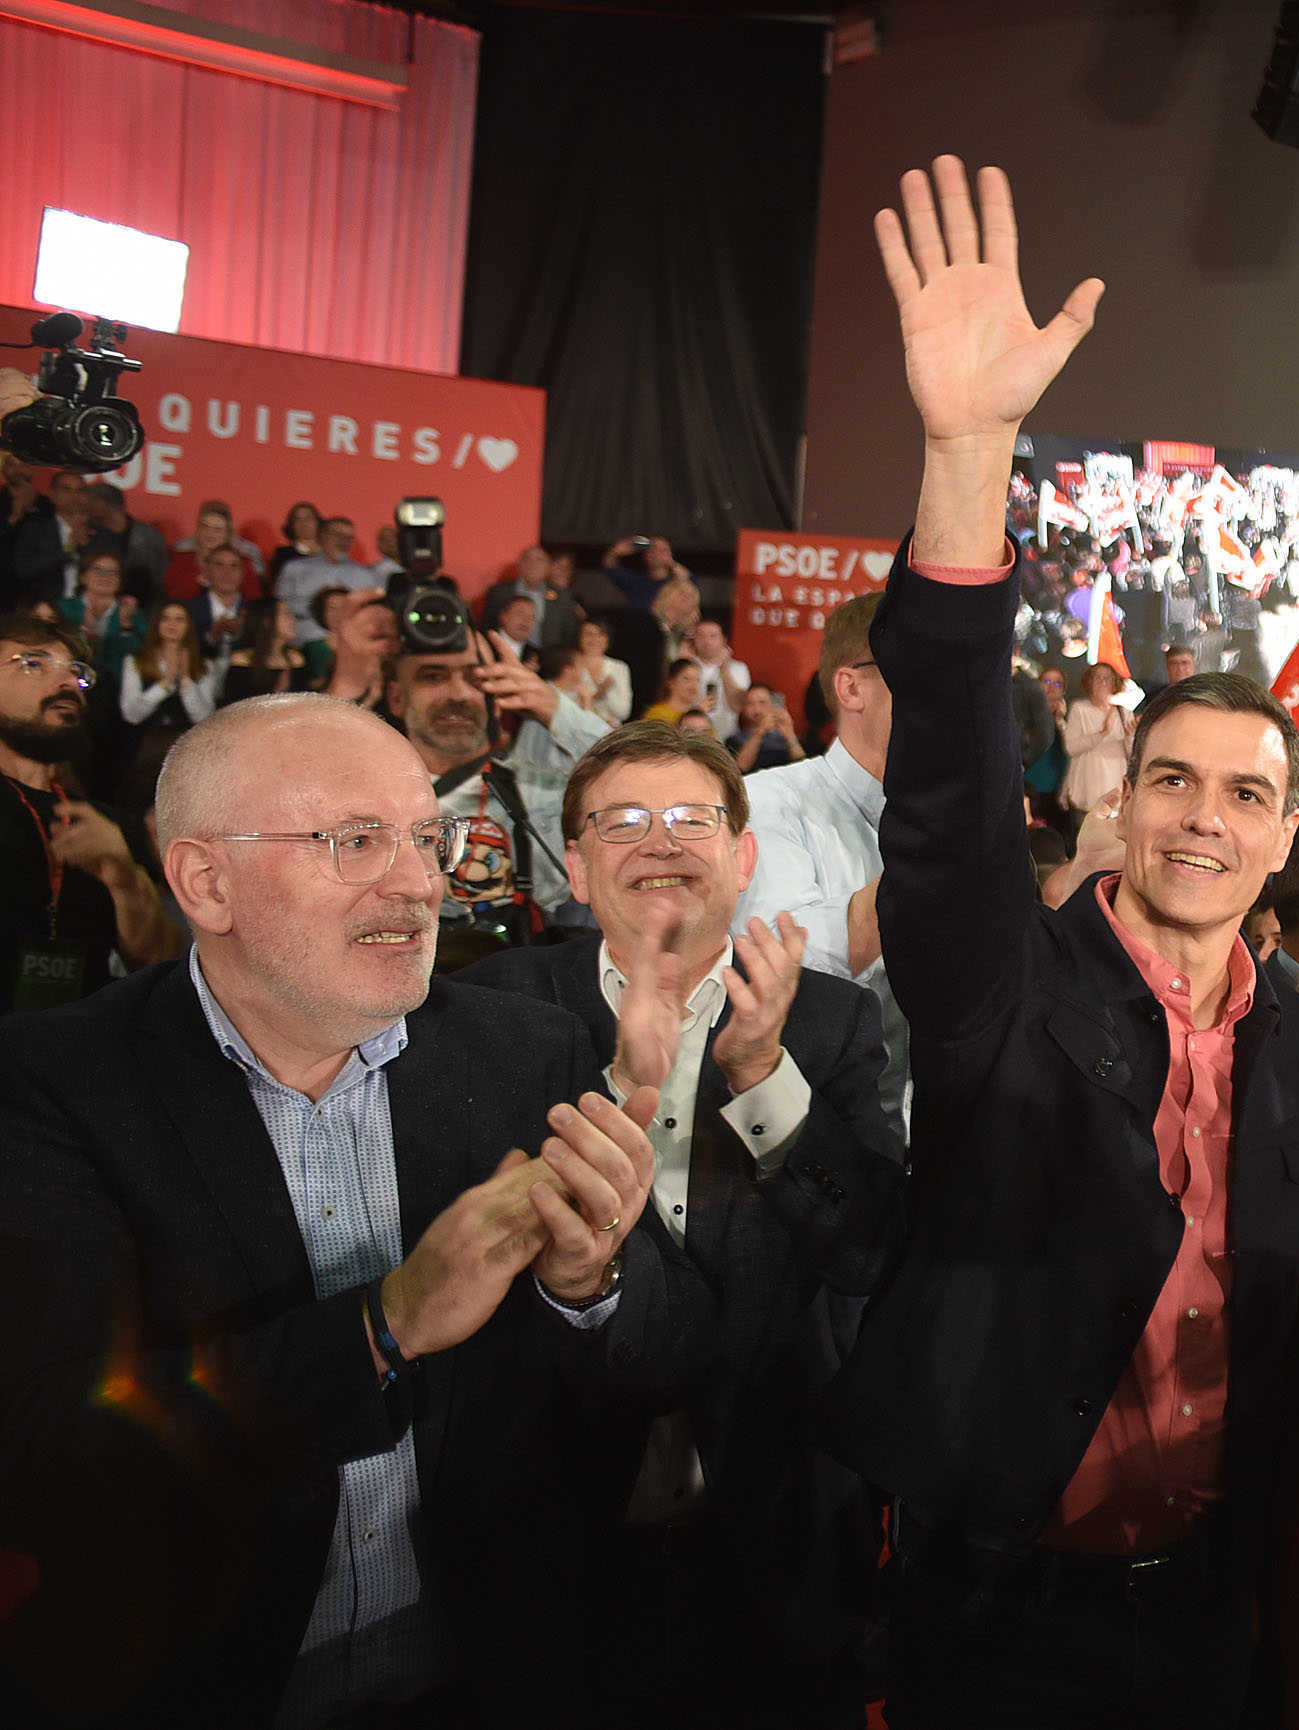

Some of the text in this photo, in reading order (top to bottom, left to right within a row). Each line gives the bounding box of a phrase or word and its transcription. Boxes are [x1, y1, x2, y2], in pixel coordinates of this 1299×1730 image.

[752, 583, 784, 603] LA
[751, 605, 799, 628] QUE
[23, 954, 78, 979] PSOE
